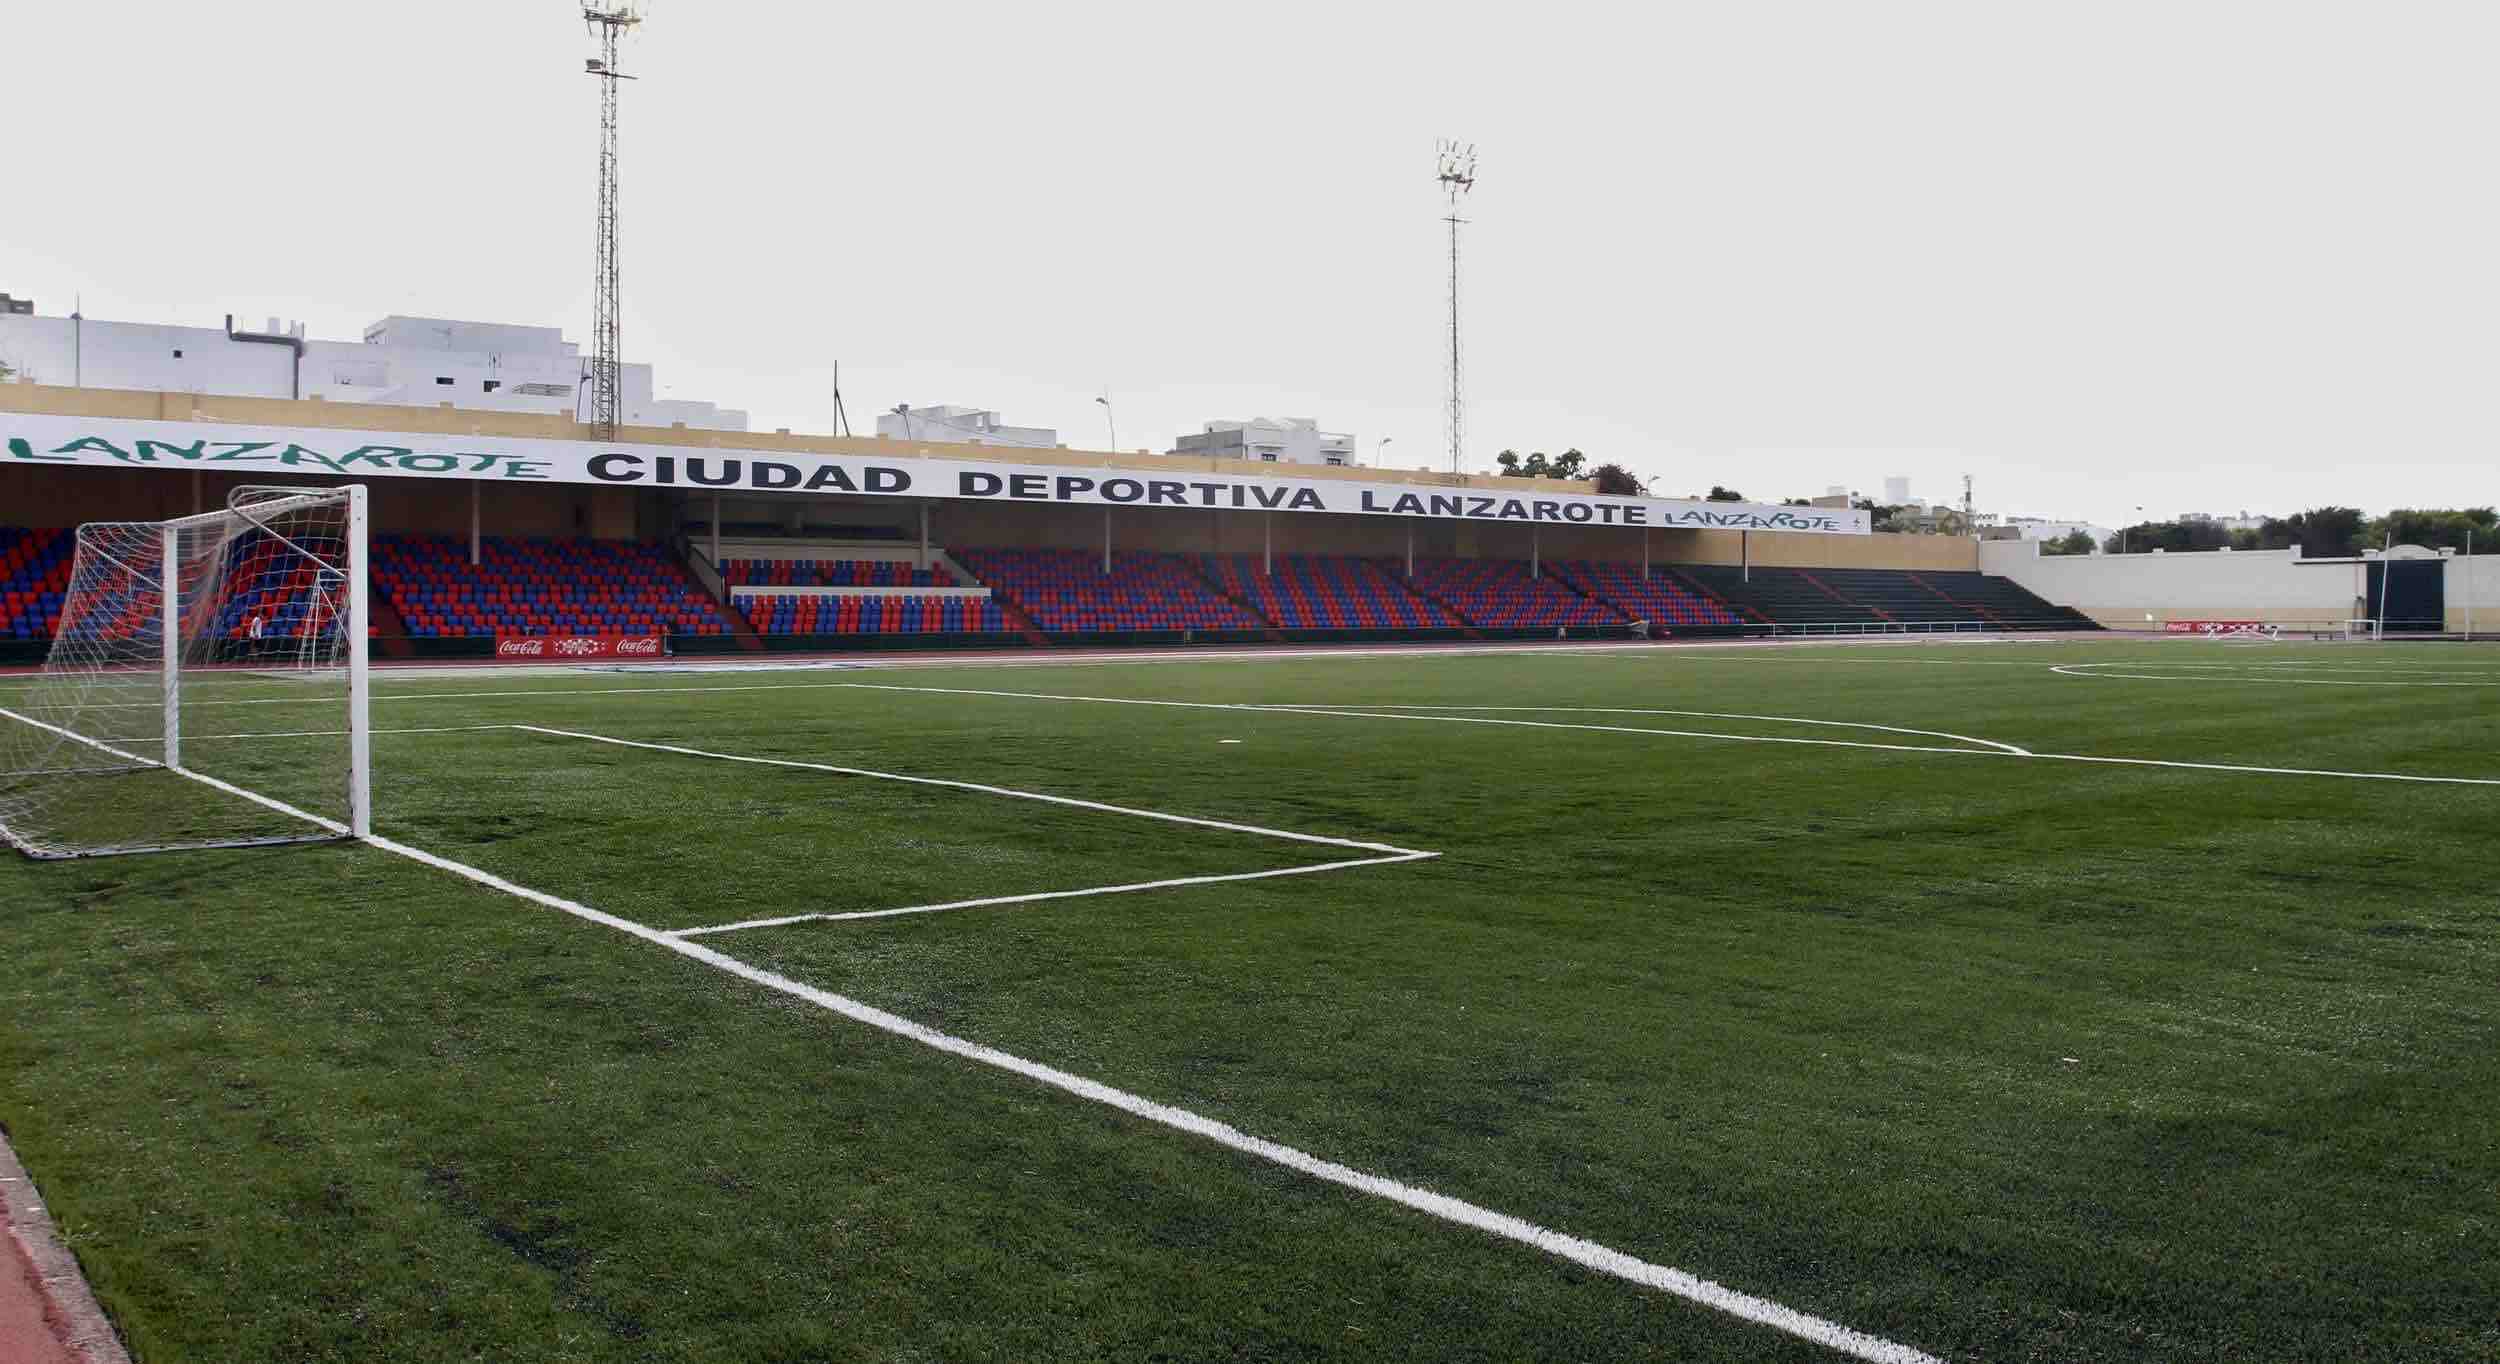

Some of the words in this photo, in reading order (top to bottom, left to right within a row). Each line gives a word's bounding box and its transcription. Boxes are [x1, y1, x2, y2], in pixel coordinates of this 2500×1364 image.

[8, 436, 553, 479] LANZAROTE
[586, 453, 912, 493] CIUDAD
[959, 471, 1327, 510] DEPORTIVA
[1361, 490, 1648, 525] LANZAROTE
[1664, 510, 1841, 531] LANZAROTE
